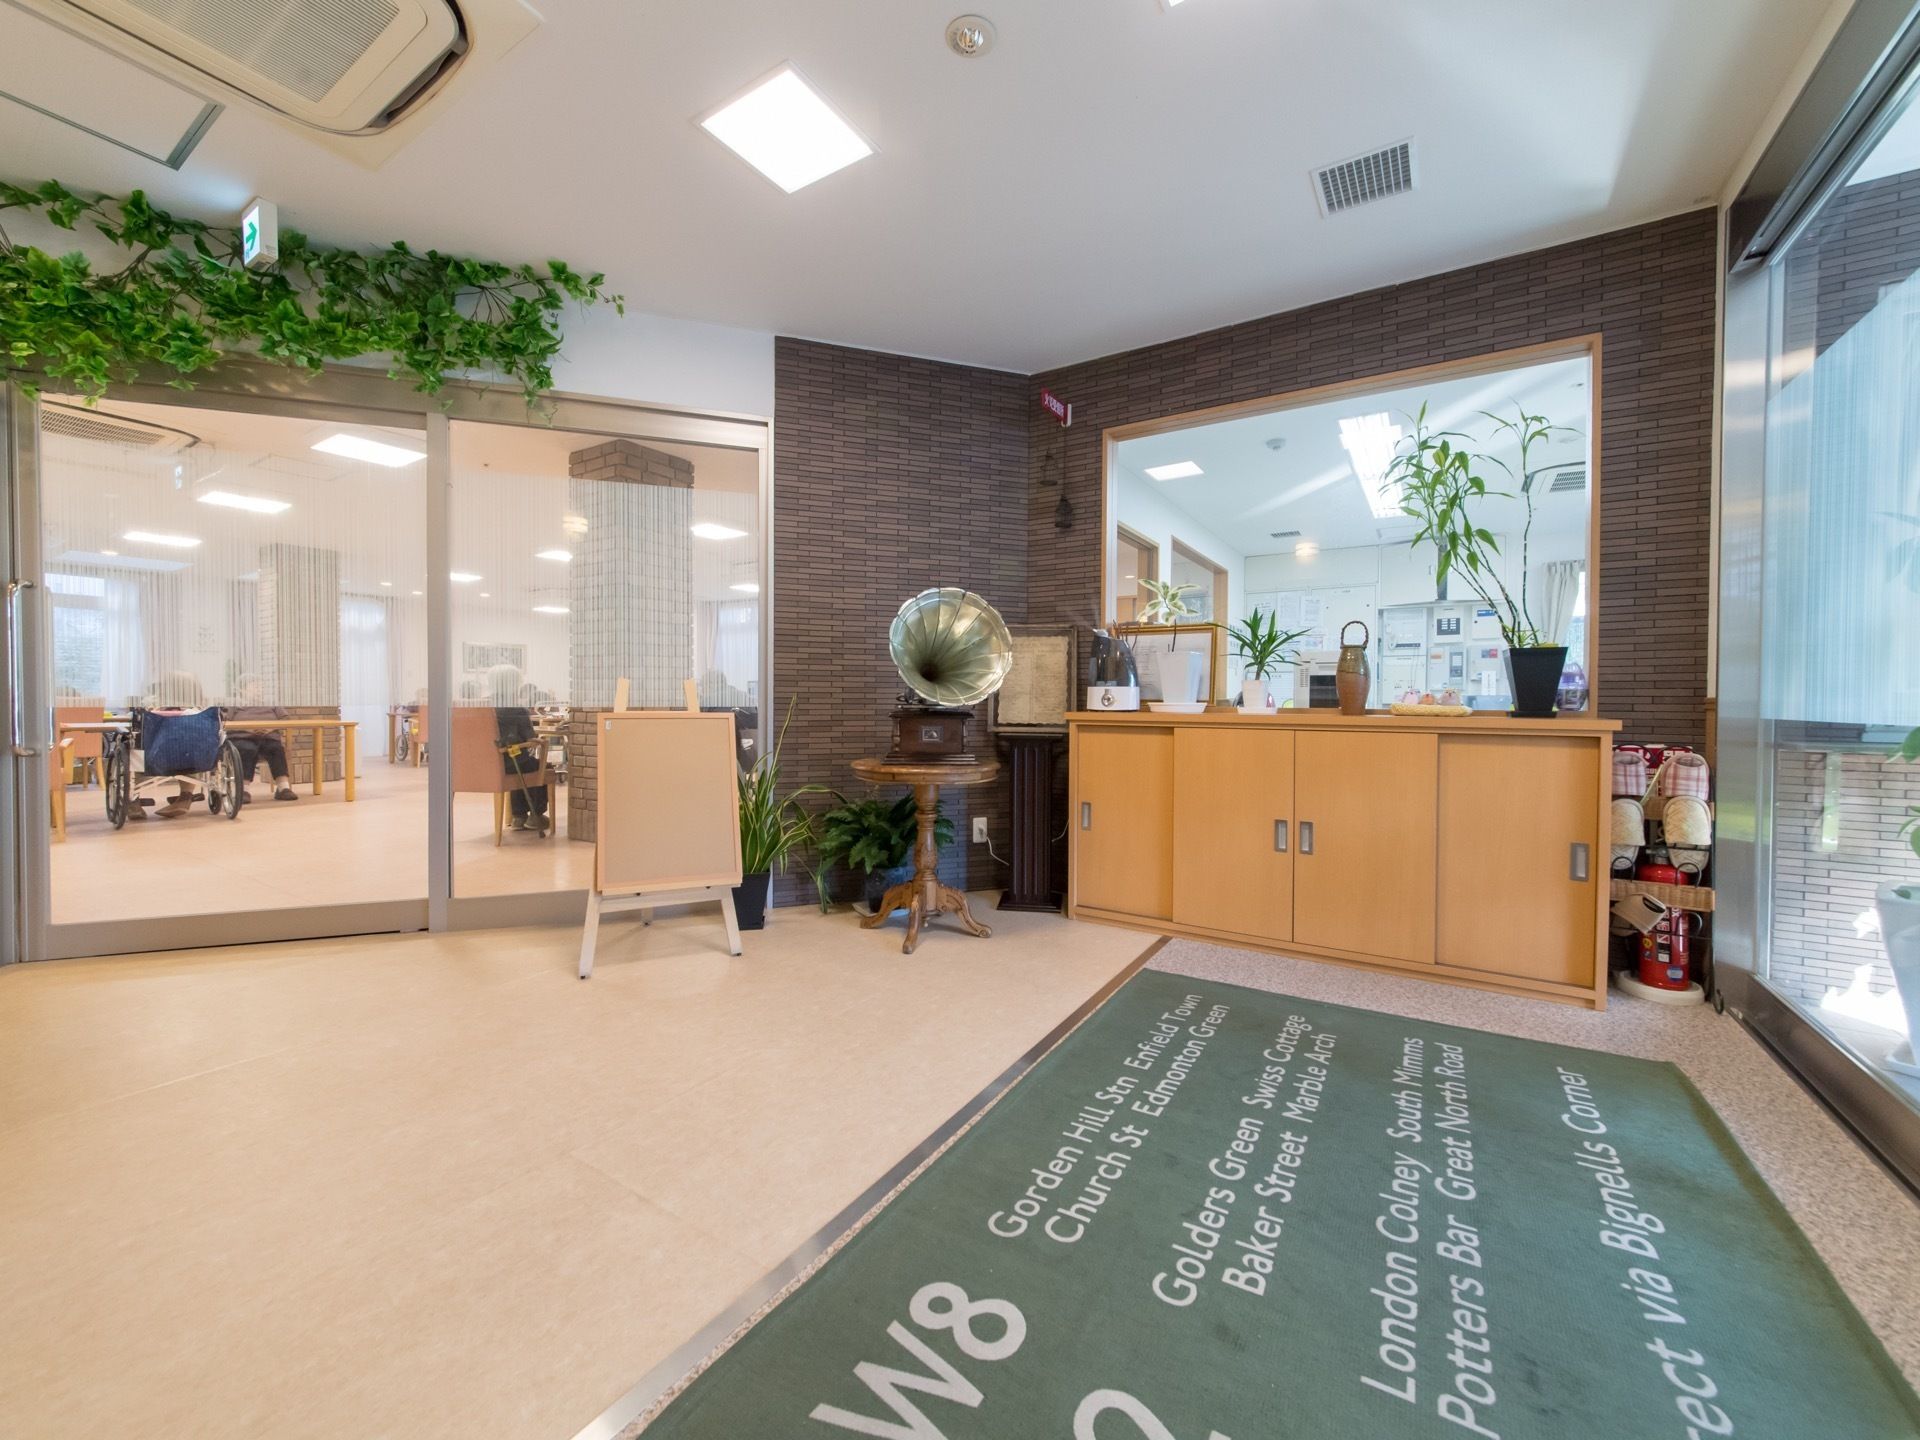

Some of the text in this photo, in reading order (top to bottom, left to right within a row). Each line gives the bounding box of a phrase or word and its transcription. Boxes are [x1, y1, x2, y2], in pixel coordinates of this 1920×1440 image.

[987, 994, 1203, 1238] Gorden Hill Stn Enfield Town
[1044, 1004, 1230, 1243] Church St Edmonton Green
[1151, 1014, 1313, 1307] Golders Green Swiss Cottage
[1221, 1033, 1337, 1297] Baker Street Marble Arch
[1360, 1037, 1433, 1404] London Colney South Mimms
[1556, 1066, 1608, 1135] Corner
[1573, 1140, 1666, 1260] Bignells
[808, 1281, 1027, 1440] W8
[1433, 1042, 1501, 1440] Potters Bar Great North Road
[1620, 1267, 1687, 1325] via
